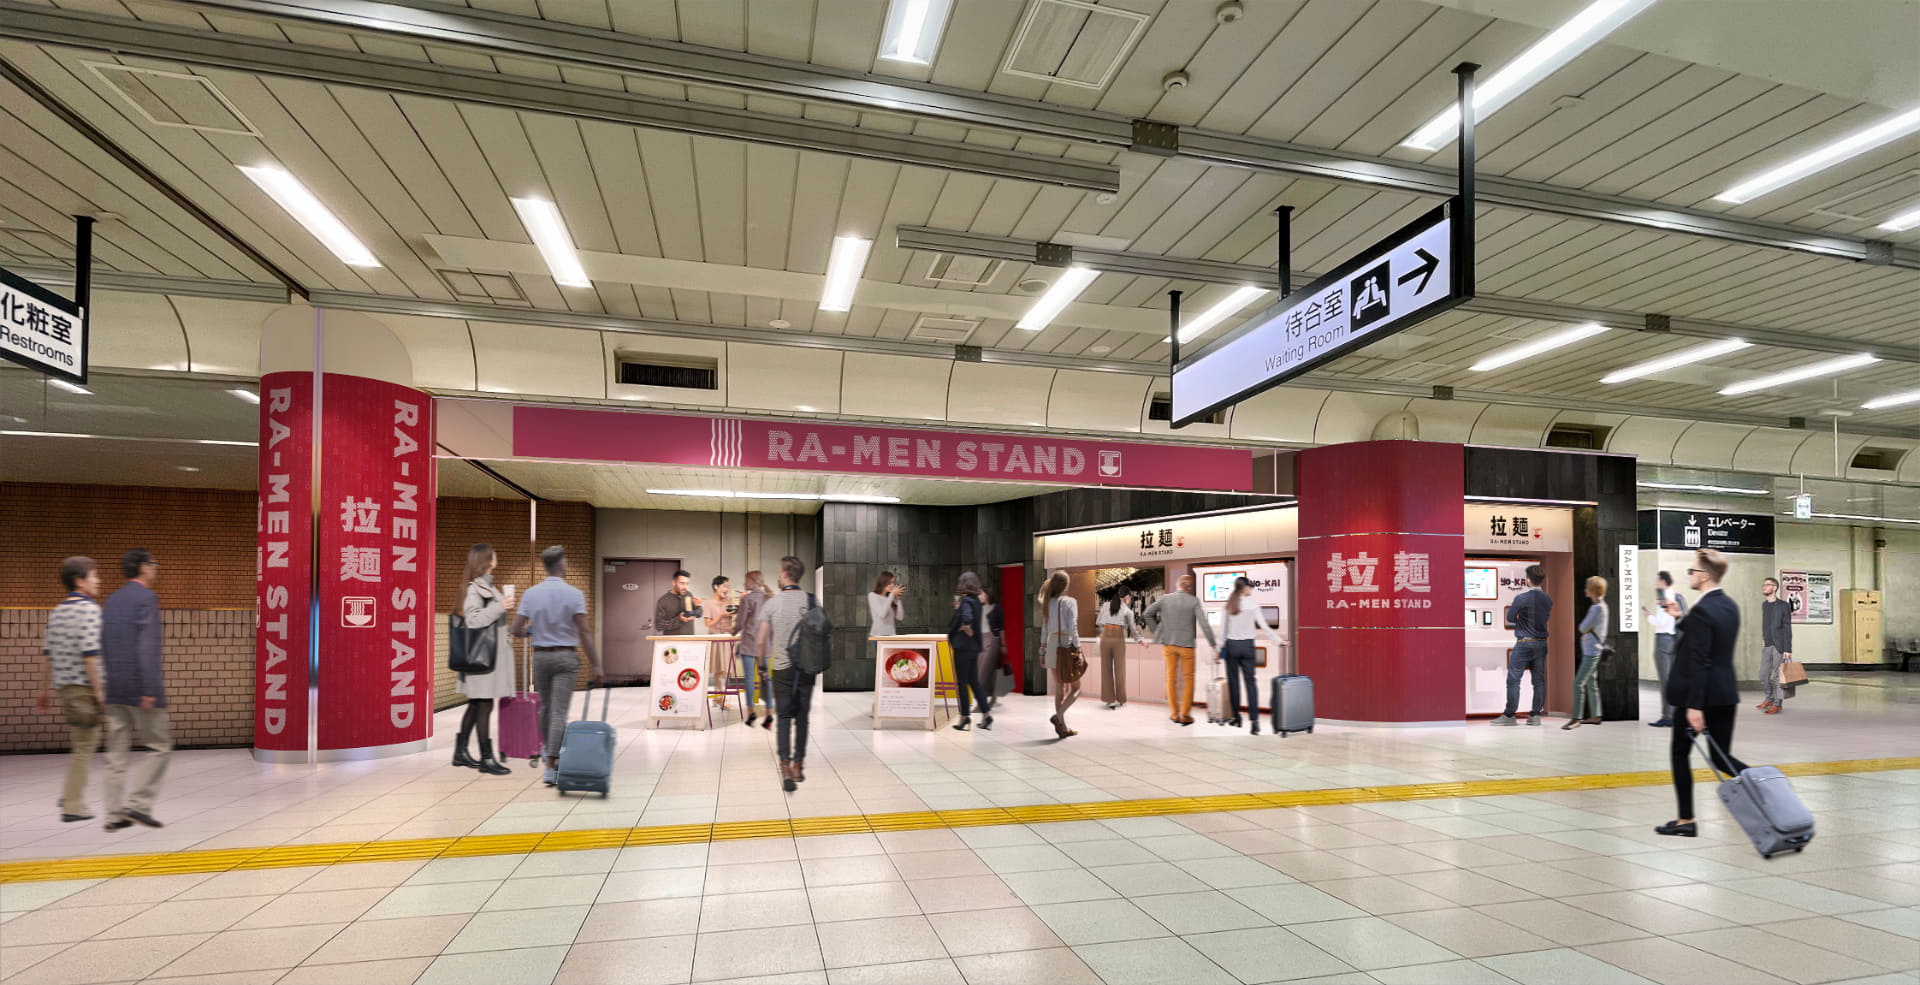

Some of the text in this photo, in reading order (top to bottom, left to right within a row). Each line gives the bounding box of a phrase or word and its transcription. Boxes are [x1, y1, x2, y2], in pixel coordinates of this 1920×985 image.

[1, 292, 72, 345] 化粧室
[1285, 288, 1343, 342] 待合室
[0, 324, 73, 366] Restrooms
[1265, 325, 1344, 372] Waiting Room
[767, 430, 1086, 475] RA-MEN STAND
[1707, 517, 1756, 529] エレベーター
[264, 387, 292, 735] RA-MEN STAND
[390, 399, 419, 729] RA-MEN STAND
[1326, 599, 1432, 609] RA-MEN STAND
[1624, 549, 1633, 629] RA-MEN STAND
